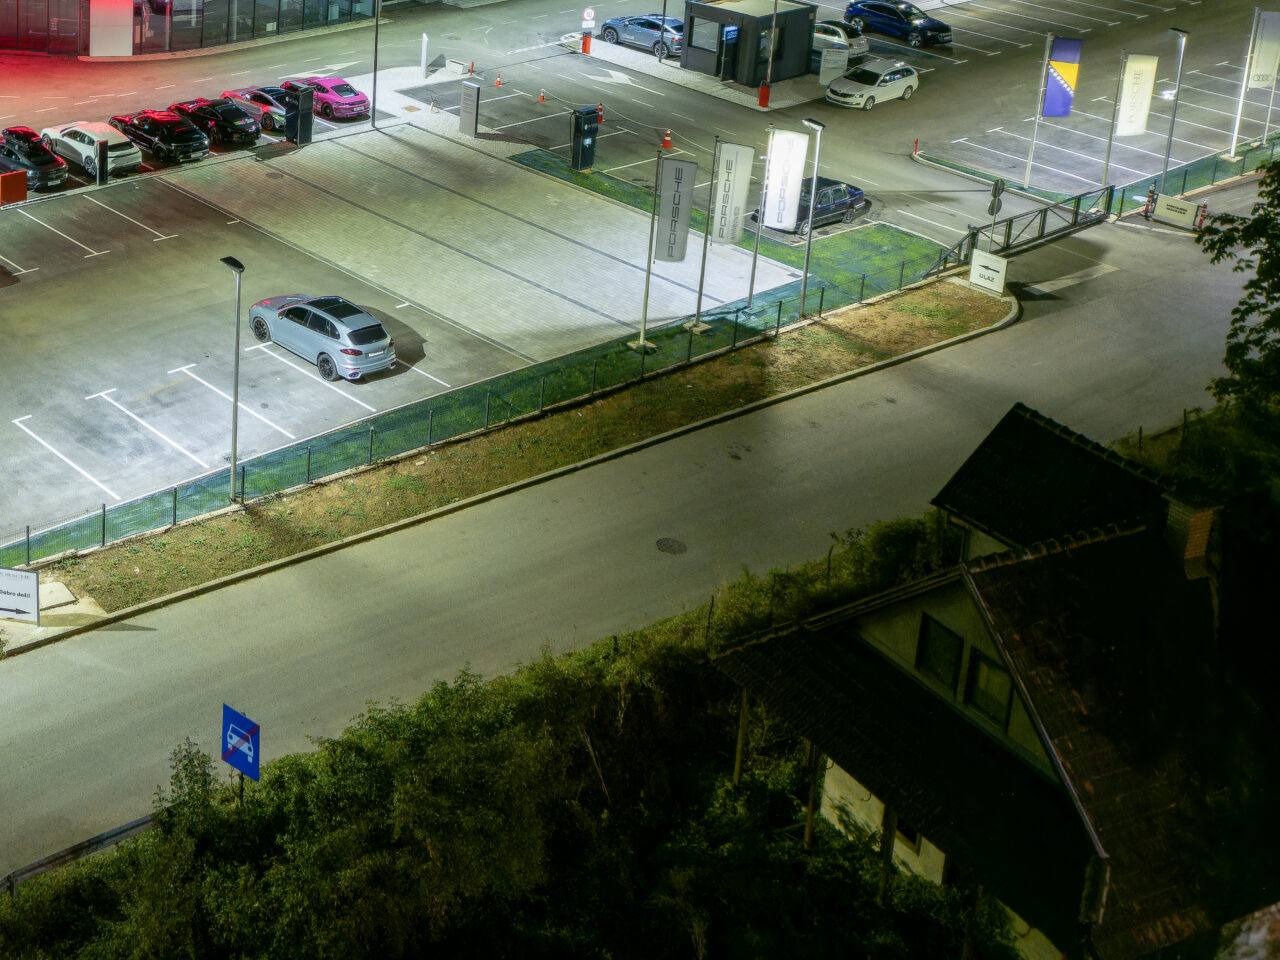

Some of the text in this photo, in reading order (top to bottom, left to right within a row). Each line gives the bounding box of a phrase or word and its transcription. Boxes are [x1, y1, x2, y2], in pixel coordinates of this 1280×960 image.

[667, 167, 683, 257] PORSCHE
[719, 159, 734, 238] PORSCHE
[979, 272, 995, 283] ULAZ
